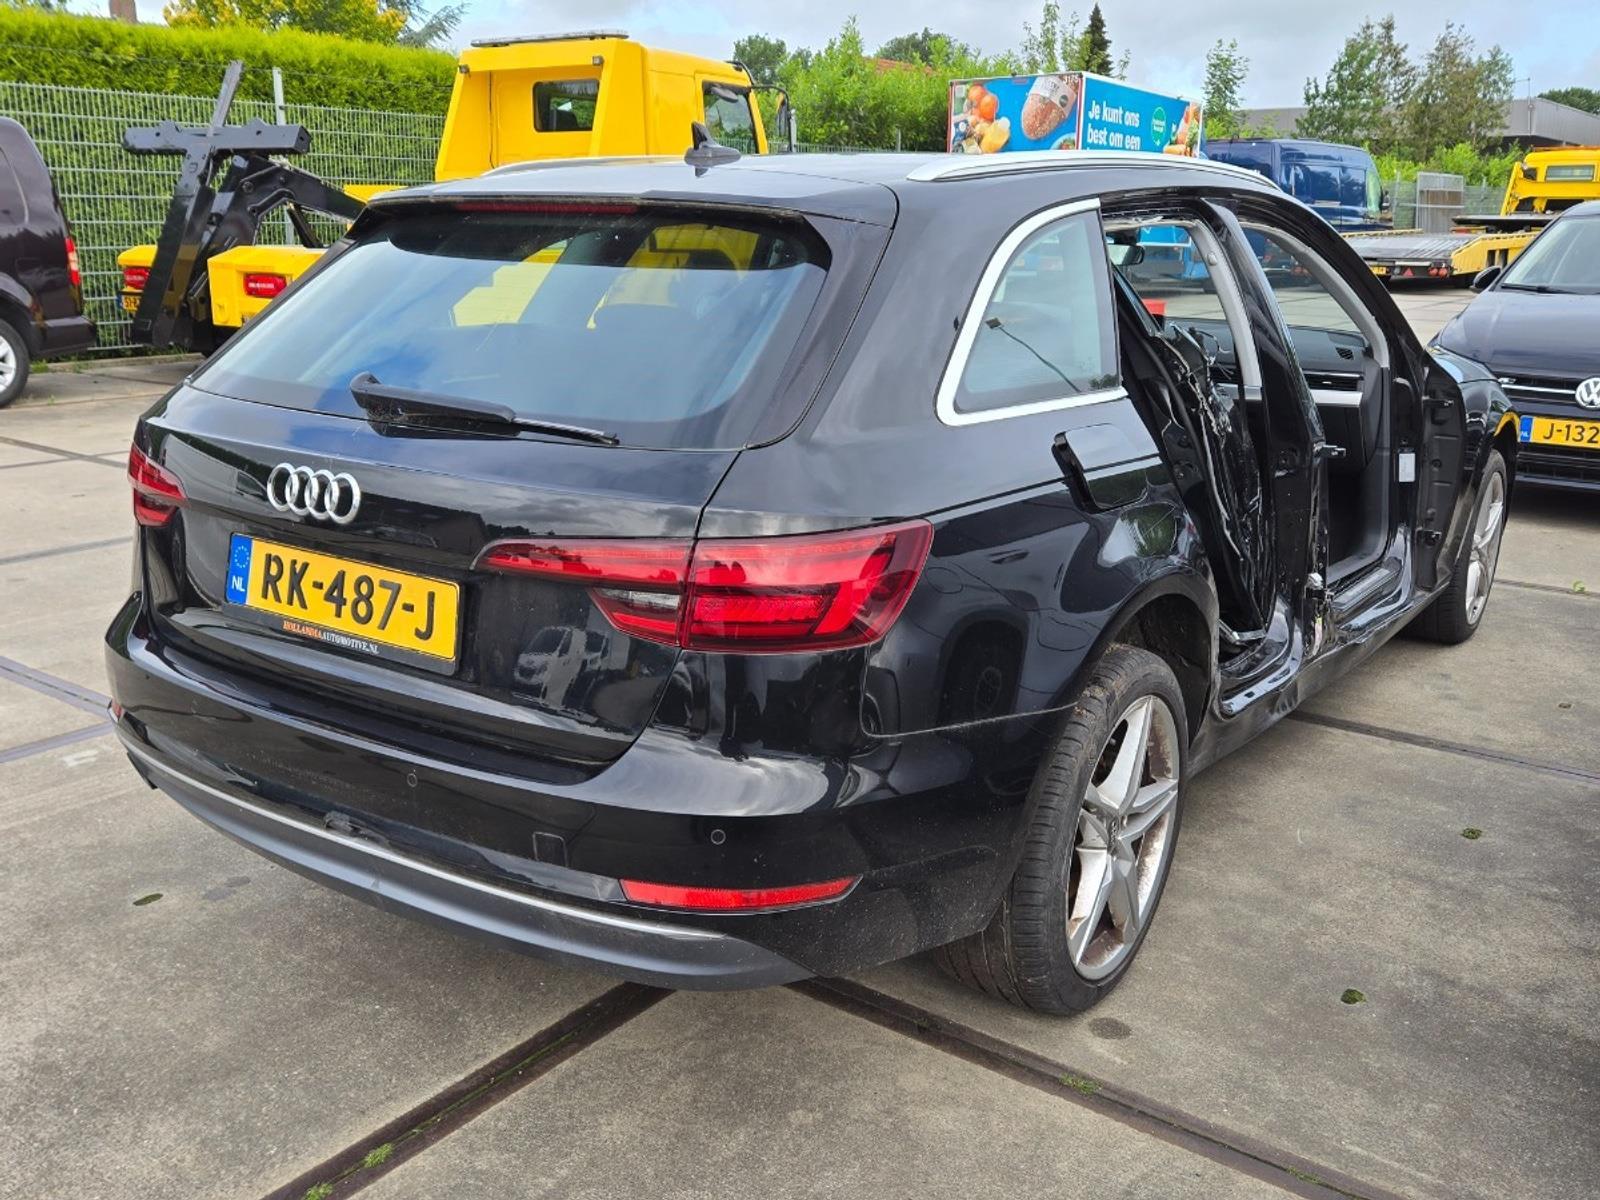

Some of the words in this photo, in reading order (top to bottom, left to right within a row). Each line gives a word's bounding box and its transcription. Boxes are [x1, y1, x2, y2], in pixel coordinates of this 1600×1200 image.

[1088, 100, 1101, 120] Je
[1102, 100, 1123, 124] kunt
[1124, 111, 1140, 128] ons
[1087, 123, 1107, 146] best
[1109, 132, 1123, 148] om
[1125, 135, 1141, 150] een
[1543, 423, 1600, 444] J-132
[232, 575, 245, 592] NL
[261, 553, 436, 640] RK-487-J
